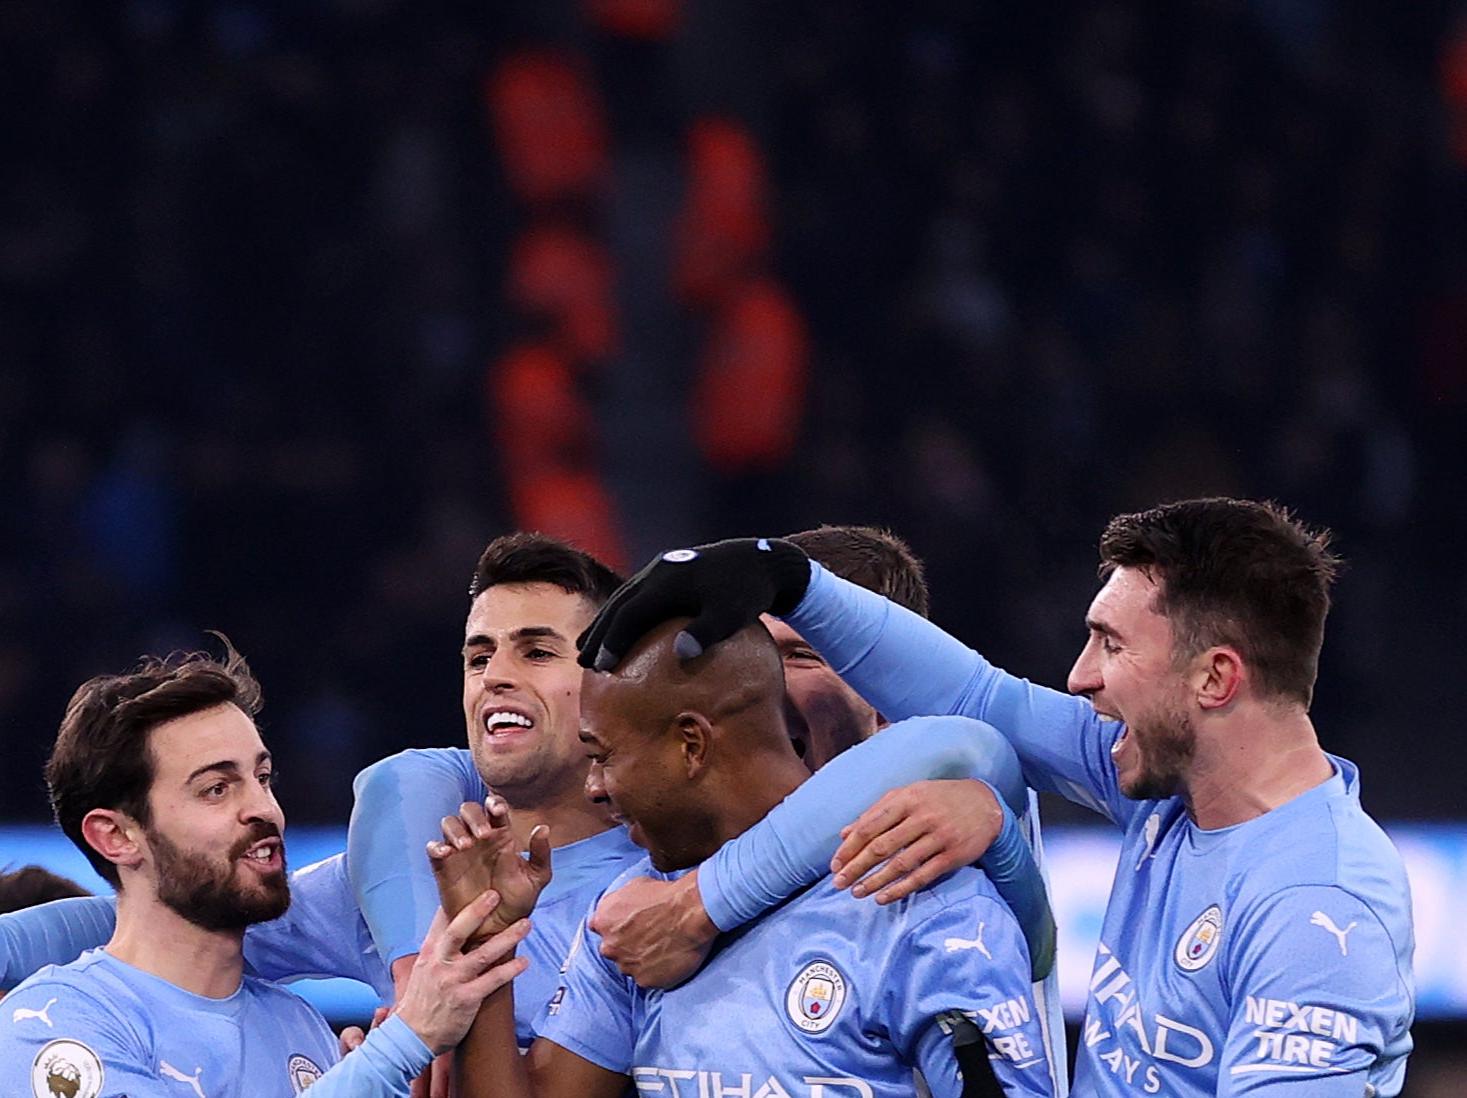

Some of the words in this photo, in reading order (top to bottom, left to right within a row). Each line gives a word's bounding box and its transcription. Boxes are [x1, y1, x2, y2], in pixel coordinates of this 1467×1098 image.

[799, 965, 842, 991] MANCHESTER
[801, 1019, 820, 1029] CITY
[1090, 942, 1214, 1068] IHAD
[1245, 995, 1358, 1044] NEXEN
[993, 1032, 1034, 1062] RE
[1084, 1015, 1161, 1094] WAYS
[1254, 1029, 1335, 1068] TIRE
